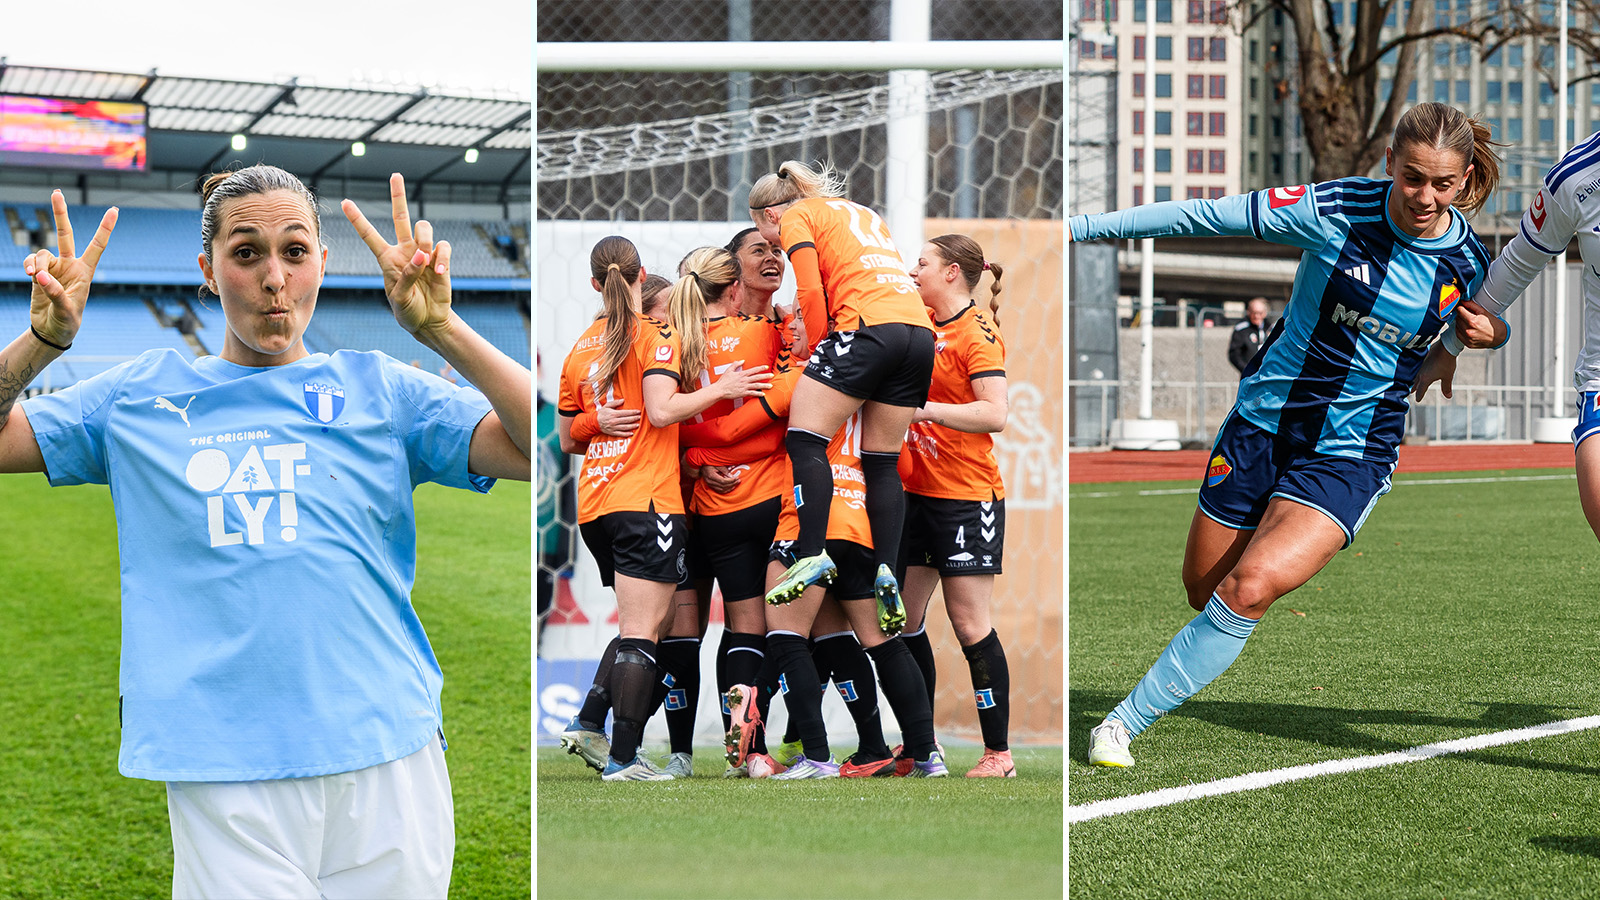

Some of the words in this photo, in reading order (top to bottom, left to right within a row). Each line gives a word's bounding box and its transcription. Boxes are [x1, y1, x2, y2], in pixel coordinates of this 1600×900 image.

[825, 200, 897, 253] 22
[189, 435, 214, 446] THE
[216, 429, 271, 443] ORIGINAL
[186, 442, 311, 493] OAT-
[832, 486, 867, 502] STARK
[207, 492, 298, 548] LY!
[955, 525, 966, 549] 4
